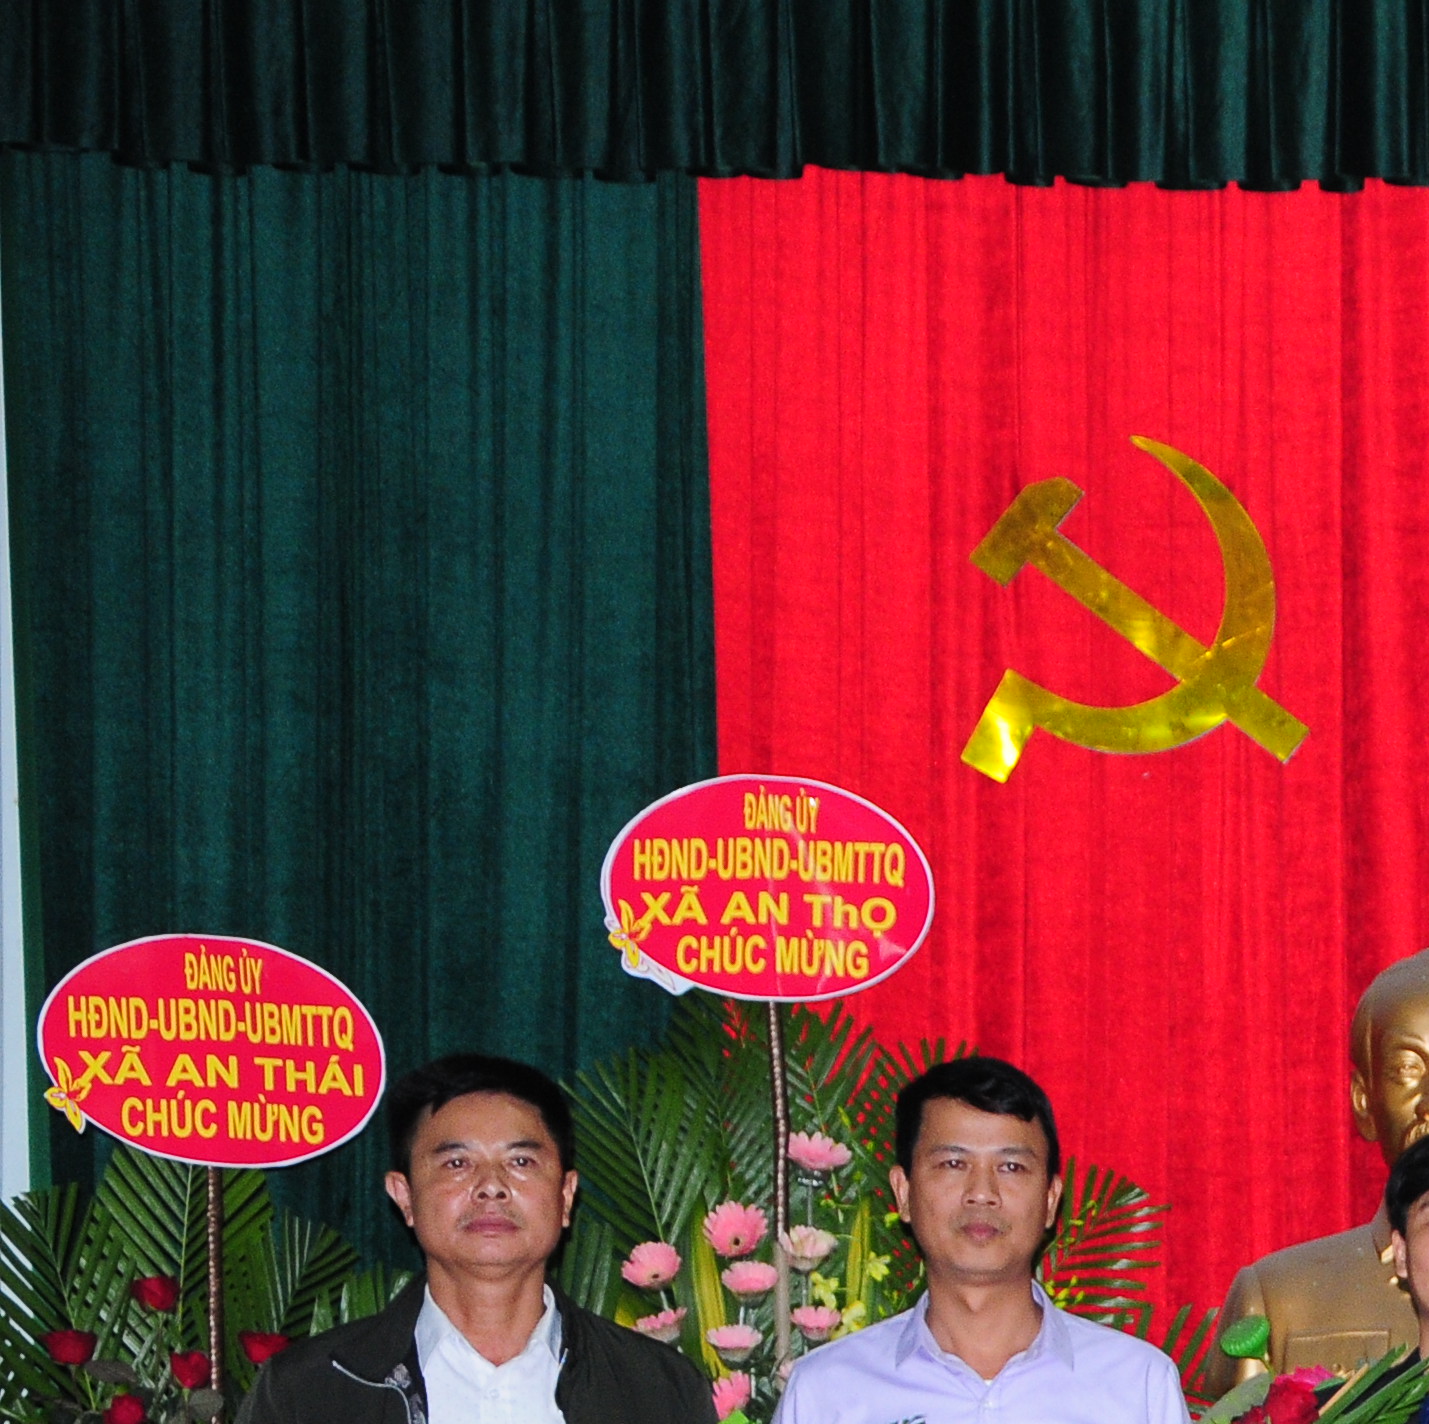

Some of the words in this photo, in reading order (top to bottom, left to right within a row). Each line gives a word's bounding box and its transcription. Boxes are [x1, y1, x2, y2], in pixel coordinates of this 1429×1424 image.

[744, 785, 792, 831] ĐẢNG
[796, 788, 819, 834] ỦY
[633, 837, 905, 888] HĐND-UBND-UBMTTQ
[640, 885, 708, 925] XÃ
[721, 891, 789, 925] AN
[184, 945, 236, 992] ĐẢNG
[239, 949, 262, 994] ỦY
[677, 926, 767, 974] CHÚC
[775, 929, 869, 979] MỪNG
[67, 996, 354, 1052] HĐND-UBND-UBMTTQ
[78, 1046, 151, 1086] XÃ
[166, 1054, 238, 1089] AN
[254, 1055, 364, 1097] THÁI
[121, 1090, 218, 1138] CHÚC
[228, 1094, 325, 1144] MỪNG
